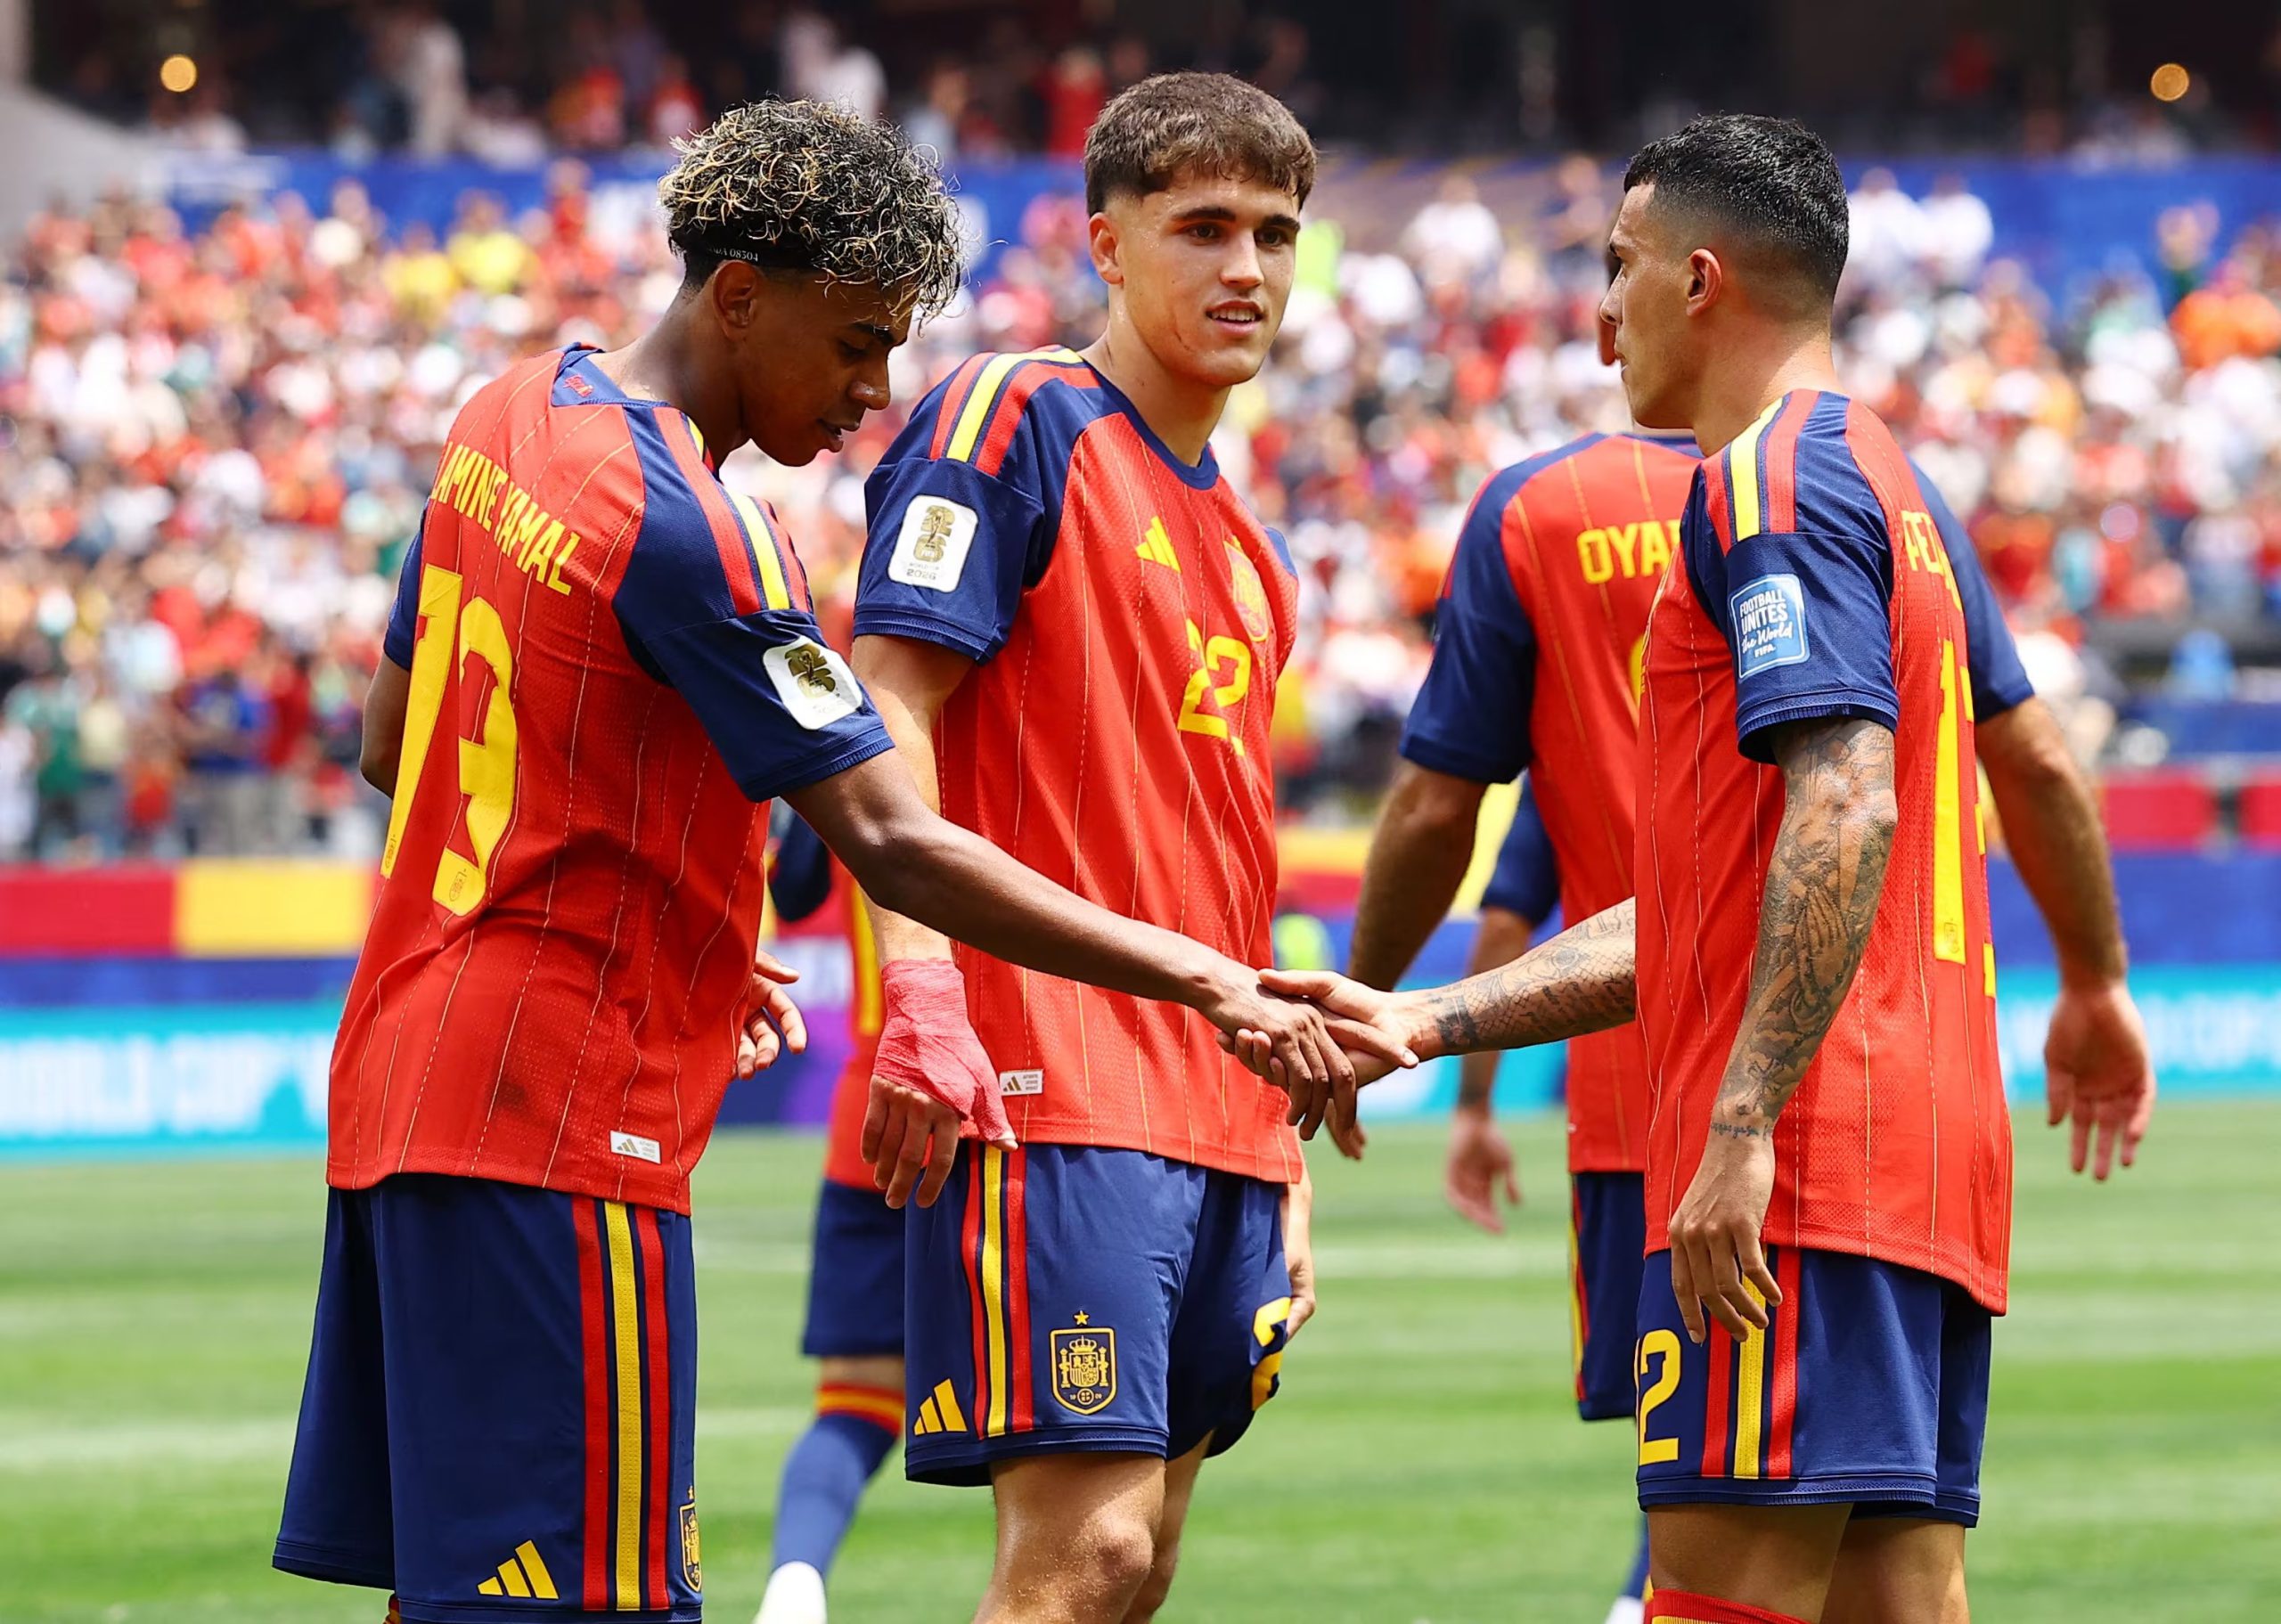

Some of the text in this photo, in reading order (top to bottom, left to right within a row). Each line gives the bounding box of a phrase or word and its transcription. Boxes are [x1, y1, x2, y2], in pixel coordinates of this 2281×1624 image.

[493, 480, 581, 596] YAMAL
[1576, 519, 1680, 584] OYA
[1739, 589, 1786, 617] FOOTBALL
[1741, 603, 1788, 635] UNITES
[1741, 622, 1793, 654] the World
[1754, 643, 1776, 657] FIFA
